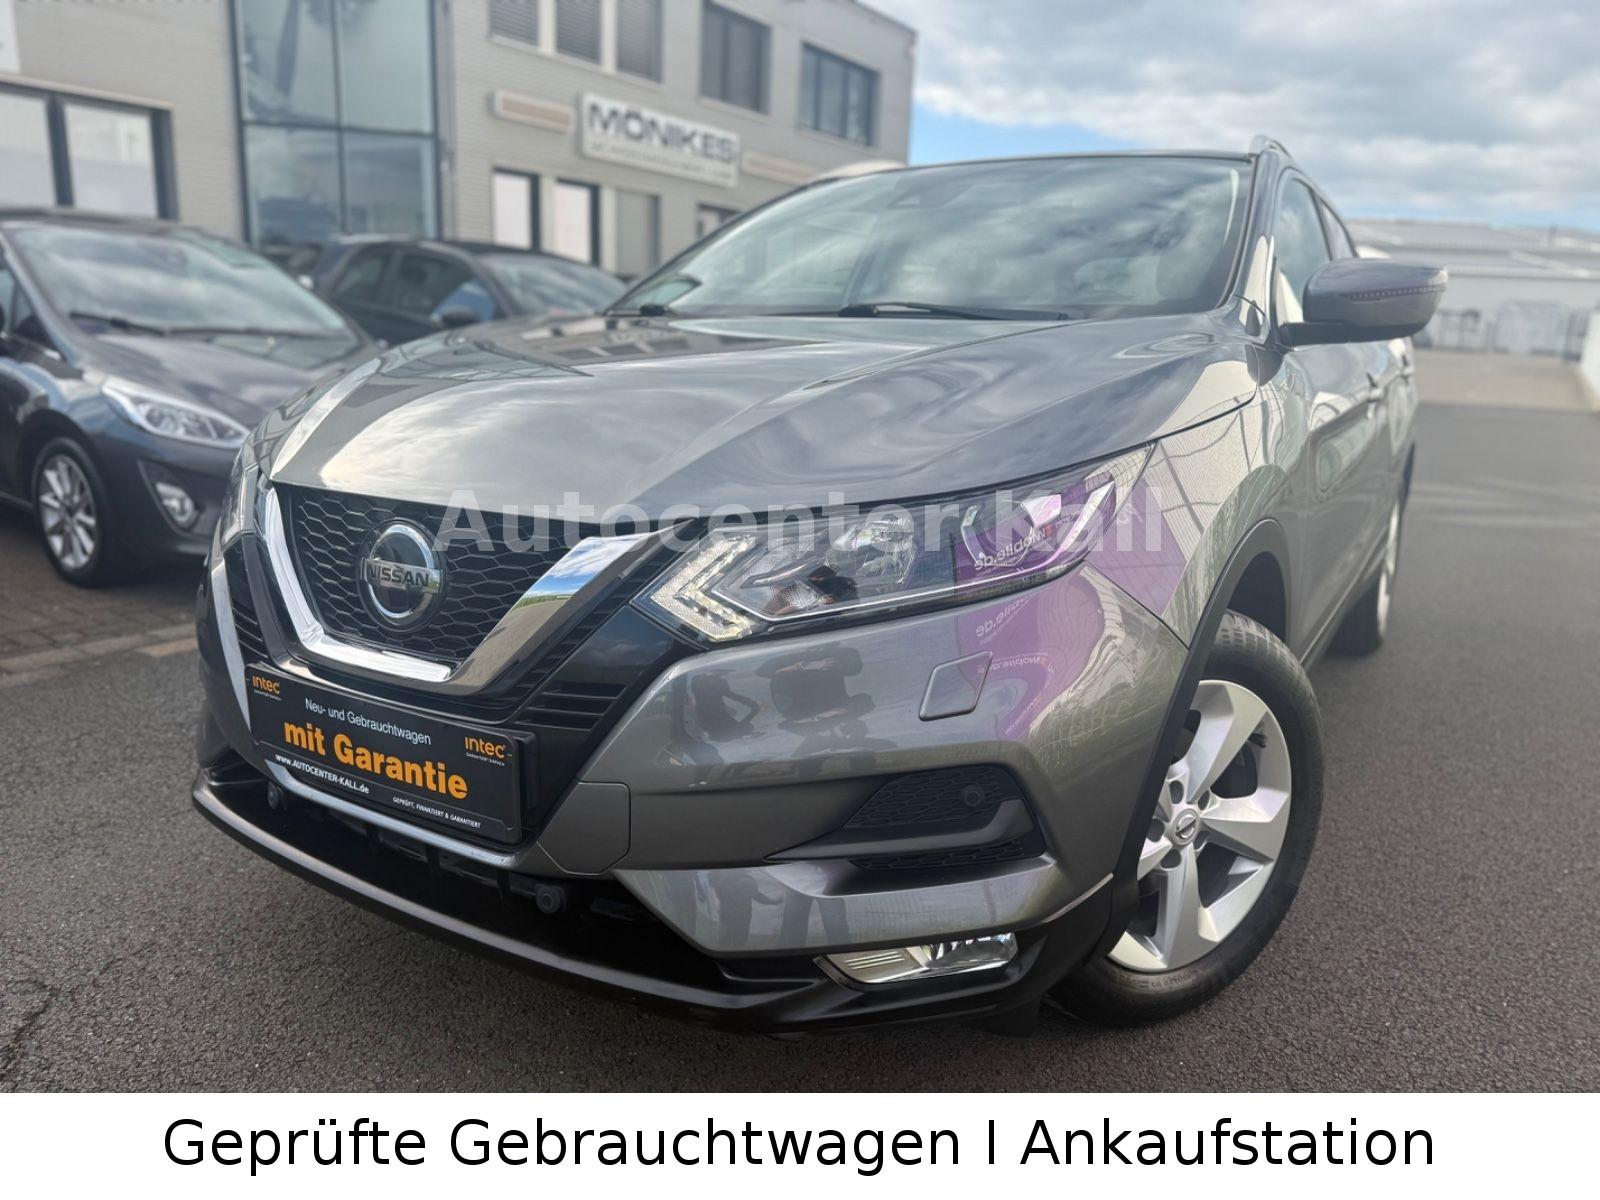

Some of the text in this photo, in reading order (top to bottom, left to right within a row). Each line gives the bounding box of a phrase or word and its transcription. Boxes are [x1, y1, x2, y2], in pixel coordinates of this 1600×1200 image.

[366, 562, 429, 587] NISSAN
[252, 675, 280, 694] intec
[305, 698, 432, 745] Neu- und Gebrauchtwagen
[284, 722, 468, 800] mit Garantie
[464, 736, 505, 759] intec
[275, 754, 370, 794] www.AUTOCENTER-KALL.de
